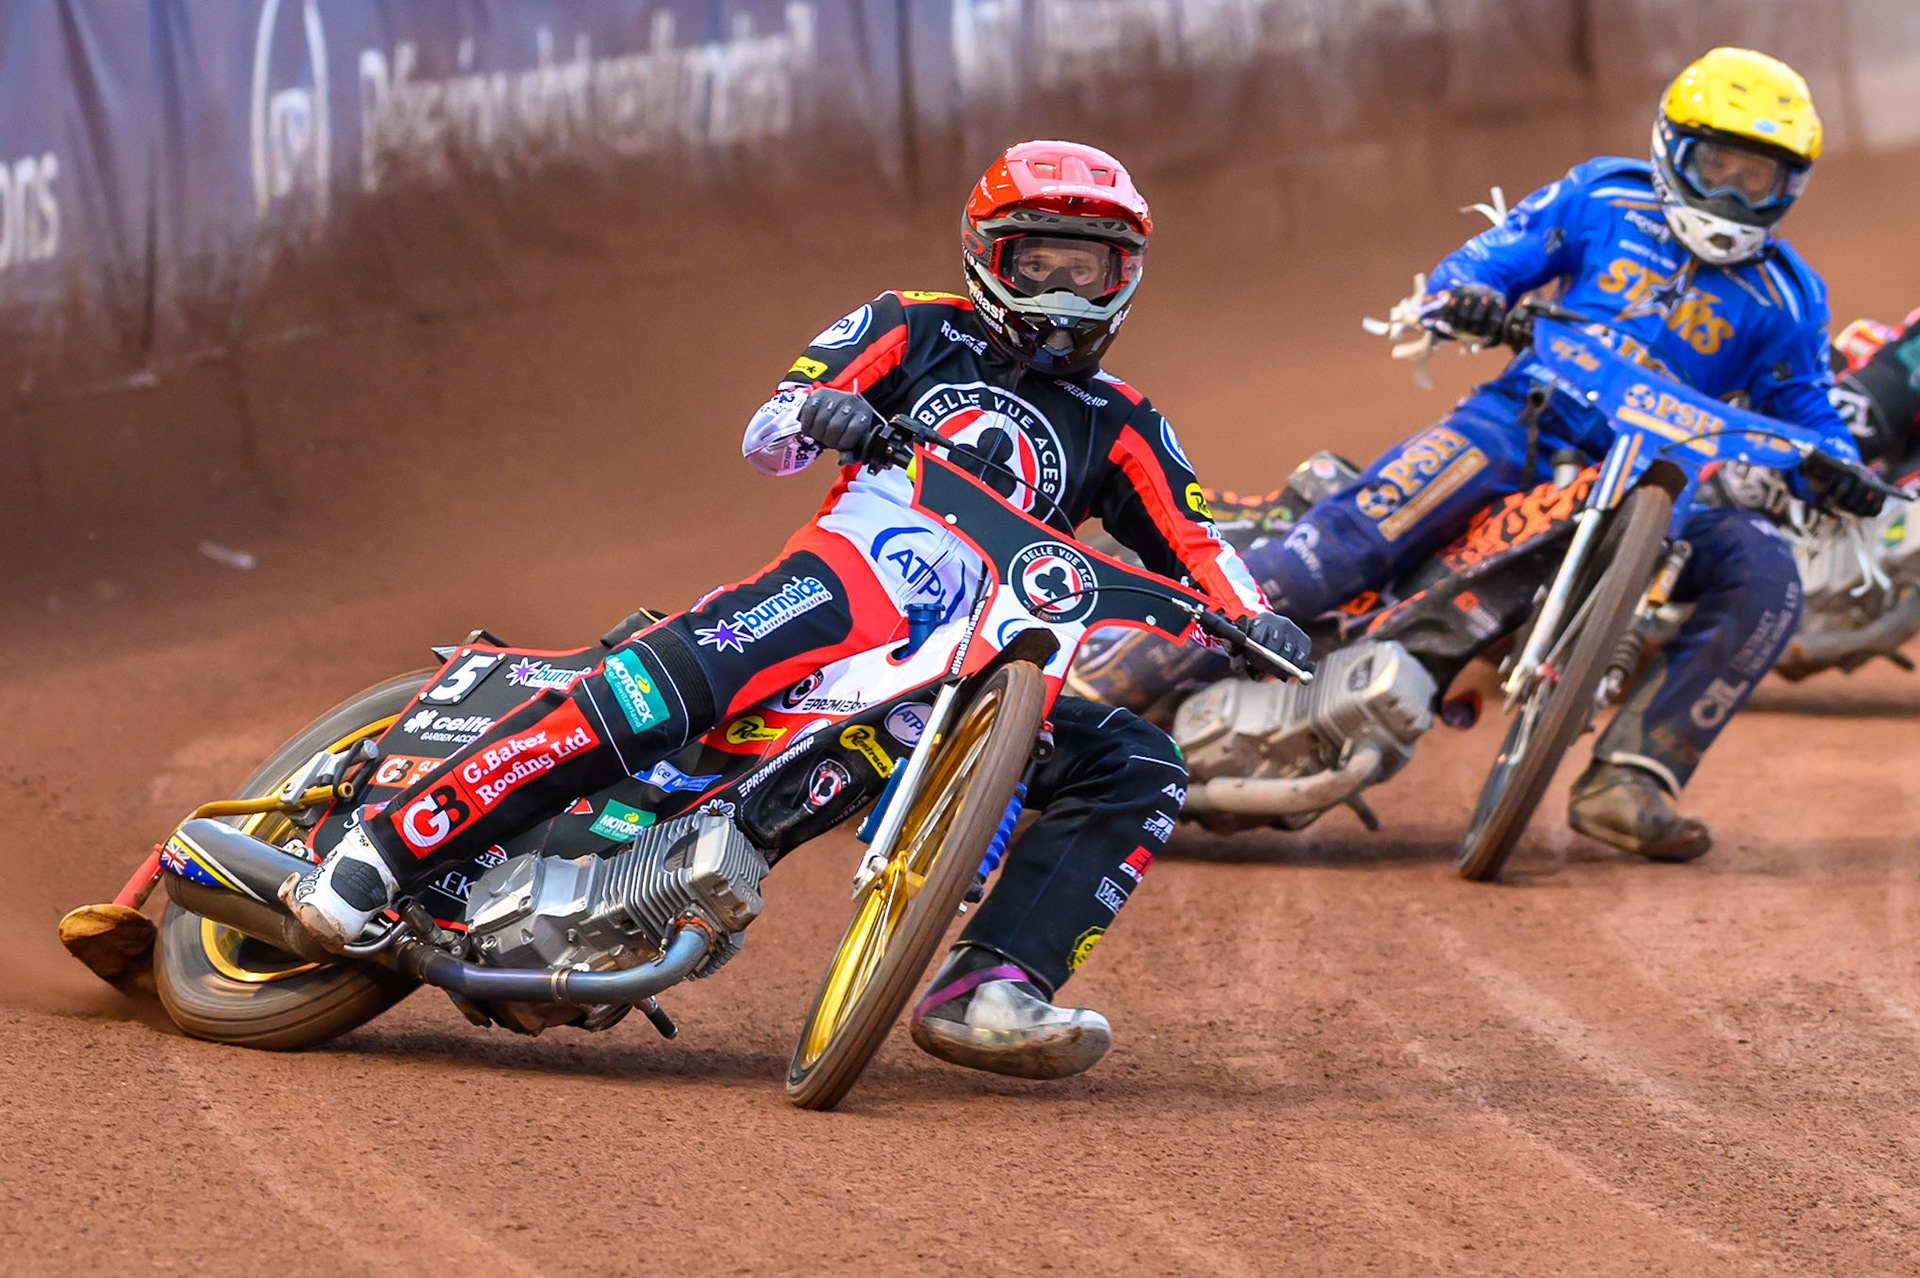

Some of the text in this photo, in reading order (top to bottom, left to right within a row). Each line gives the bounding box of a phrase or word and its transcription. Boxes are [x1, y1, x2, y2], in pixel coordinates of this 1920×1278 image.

[1655, 392, 1726, 440] PSH
[918, 391, 1059, 495] BELLE VUE ACES
[1377, 427, 1472, 496] PSH
[1021, 546, 1094, 594] BELLE VUE ACE
[735, 577, 825, 630] burnside
[755, 612, 791, 637] chartered
[428, 654, 497, 700] 5
[532, 664, 575, 685] burn
[606, 656, 656, 724] MOTOREX
[614, 681, 643, 728] Switzerland
[420, 731, 452, 742] GARDEN
[462, 730, 548, 784] G.Baker
[844, 727, 888, 774] Rentruck
[376, 757, 414, 784] GB
[475, 726, 591, 805] Roofing Ltd
[402, 785, 471, 848] GB
